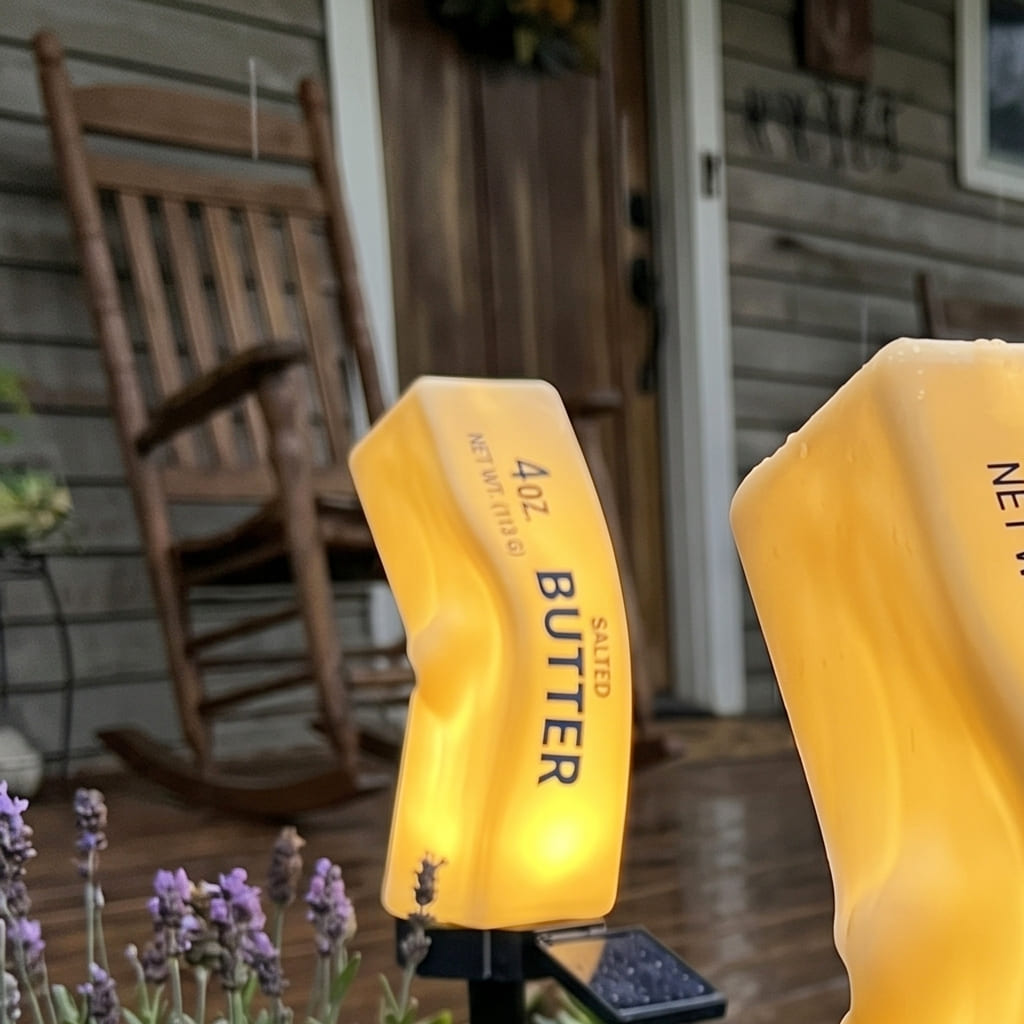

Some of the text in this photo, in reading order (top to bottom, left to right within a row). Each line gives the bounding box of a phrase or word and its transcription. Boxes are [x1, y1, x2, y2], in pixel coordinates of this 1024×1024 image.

[467, 433, 494, 464] NET
[535, 570, 585, 786] BUTTER
[591, 617, 611, 699] SALTED
